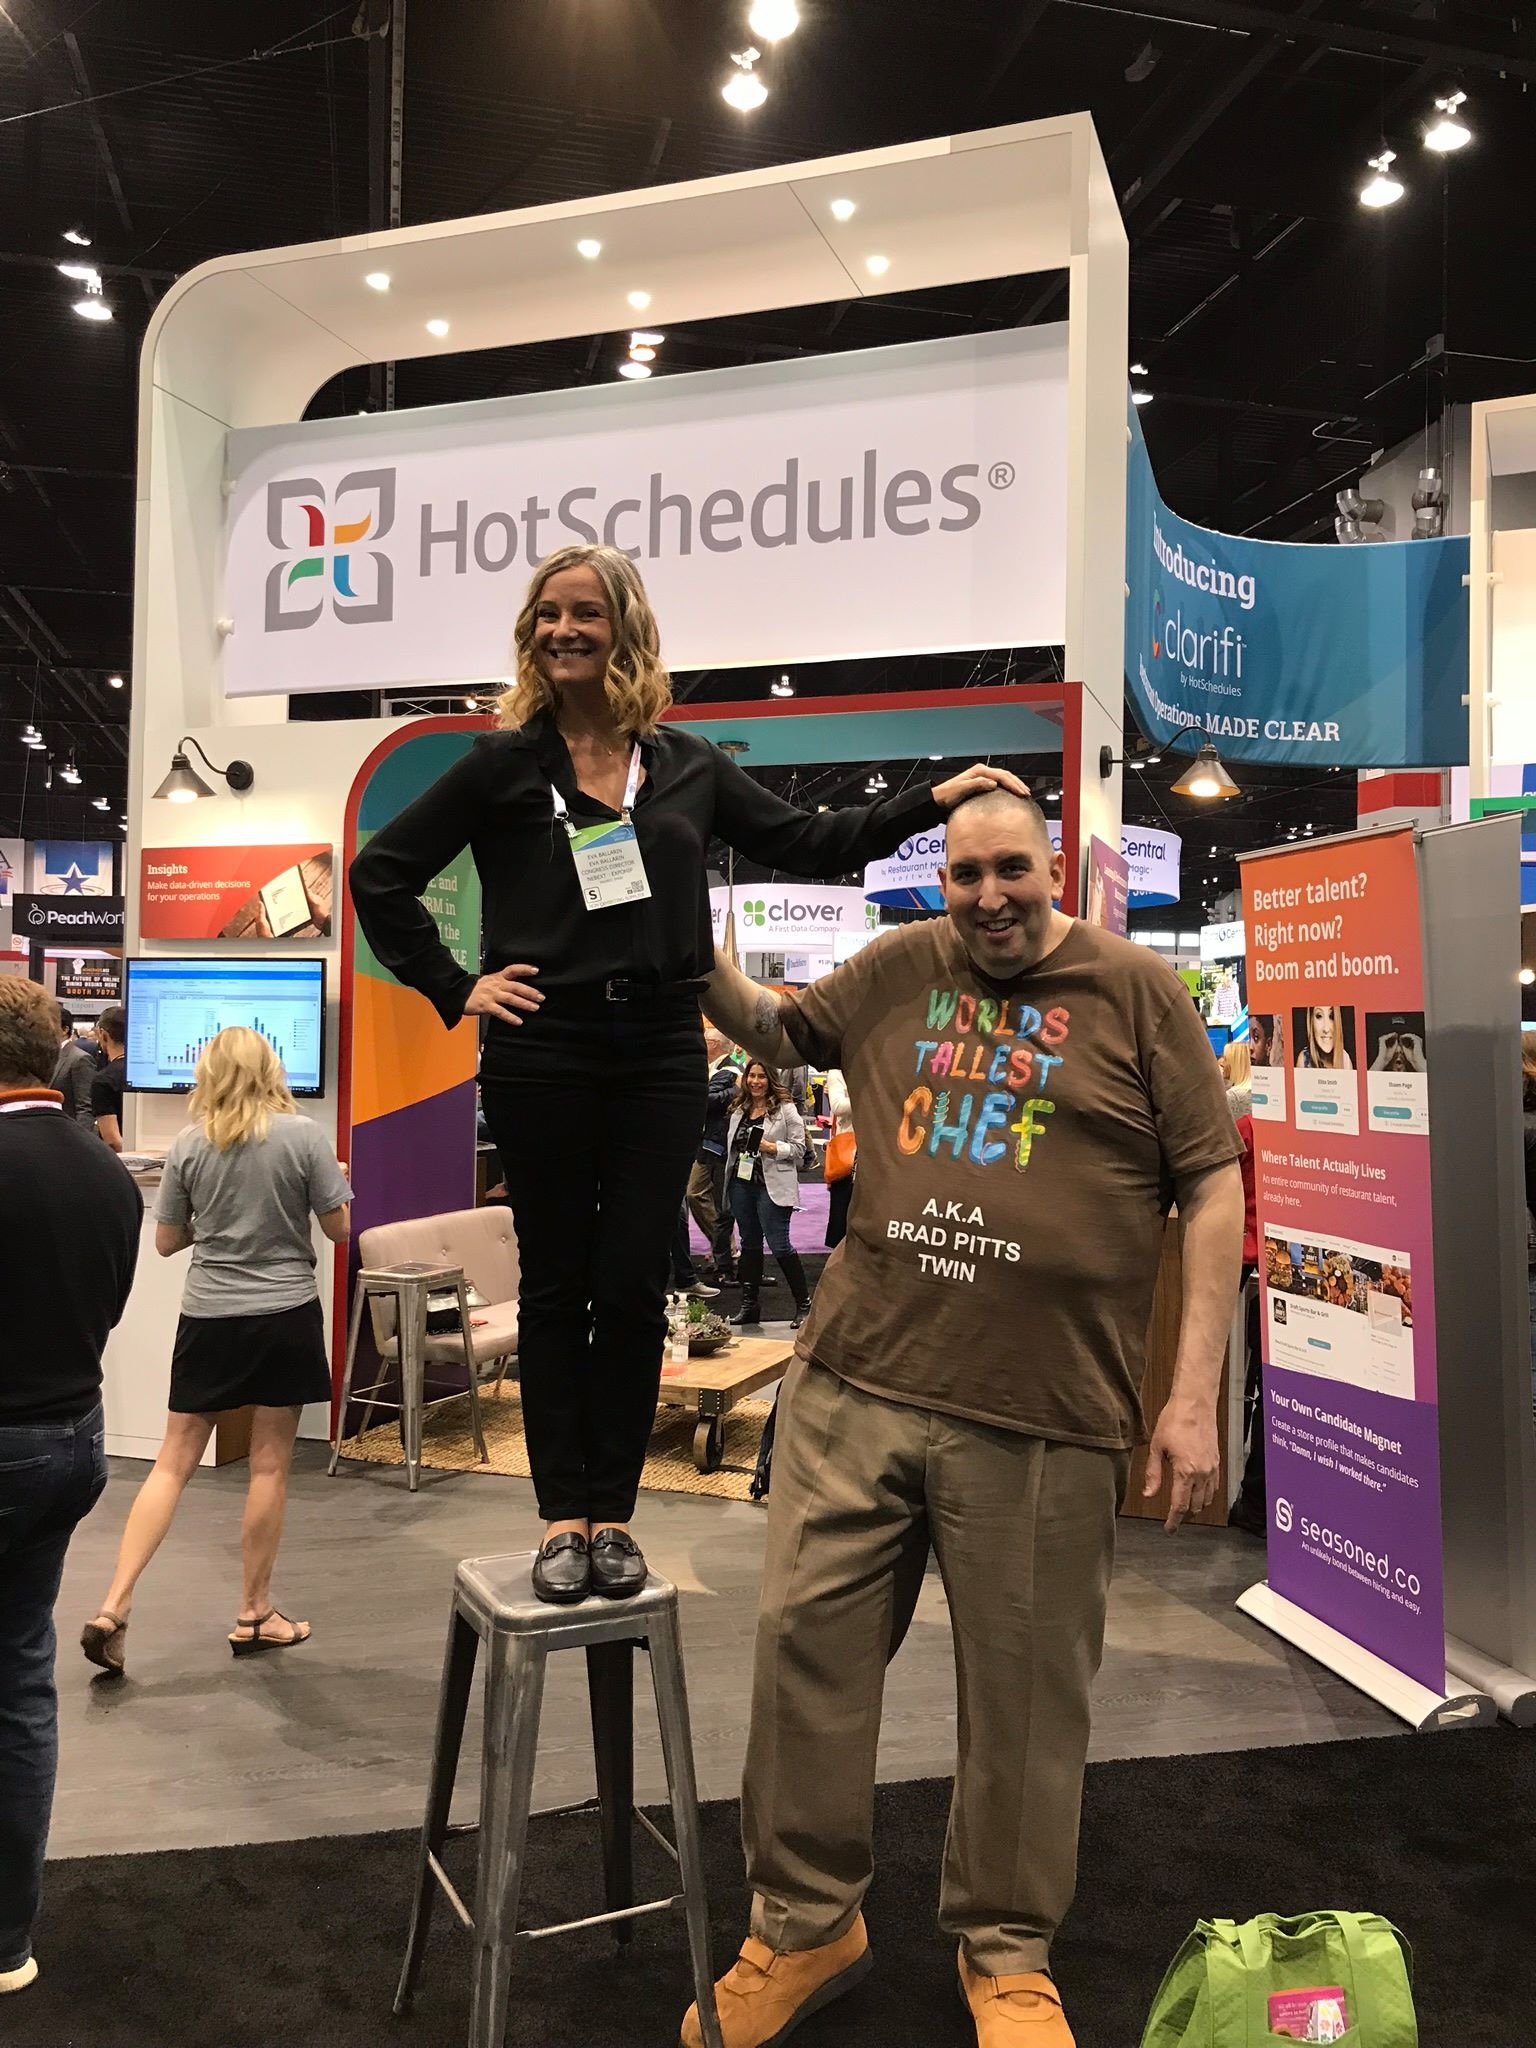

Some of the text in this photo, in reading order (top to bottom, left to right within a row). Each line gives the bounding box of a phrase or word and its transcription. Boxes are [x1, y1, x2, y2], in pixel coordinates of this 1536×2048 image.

[1153, 510, 1256, 610] Introducing
[1180, 672, 1242, 697] by HotSchedules
[1205, 712, 1260, 739] MADE
[1264, 720, 1341, 742] CLEAR
[147, 864, 188, 877] Insights
[887, 861, 928, 874] Restaurant
[147, 879, 251, 889] Make data-driven decisions
[147, 891, 220, 903] for your operations
[438, 875, 458, 892] and
[588, 889, 598, 900] S
[1253, 872, 1368, 912] Better talent?
[446, 898, 456, 916] in
[768, 898, 843, 922] clover
[444, 922, 461, 940] the
[791, 924, 808, 932] Data
[809, 925, 840, 933] Company
[1254, 921, 1294, 952] Right
[1298, 914, 1343, 942] now?
[1255, 951, 1400, 982] Boom and boom.
[926, 989, 1071, 1044] WORLDS
[914, 1040, 1064, 1091] TALLEST
[896, 1085, 1056, 1173] CHEF
[1261, 1150, 1387, 1181] Where Talent Actually Lives
[1262, 1173, 1398, 1207] An entire community of restaurant talent,
[1263, 1190, 1302, 1208] already here.
[922, 1197, 985, 1227] A.K.A
[886, 1219, 1022, 1263] BRAD PITTS
[917, 1252, 976, 1284] TWIN
[1270, 1388, 1403, 1455] Your Own Candidate Magnet
[1271, 1415, 1419, 1488] Create a store profile that makes candidates
[1272, 1433, 1289, 1450] think,
[1317, 1453, 1334, 1469] wish
[1339, 1464, 1363, 1482] worked
[1300, 1517, 1421, 1596] seasoned.co
[1301, 1540, 1422, 1615] An unlikely bond between hiring and easy.
